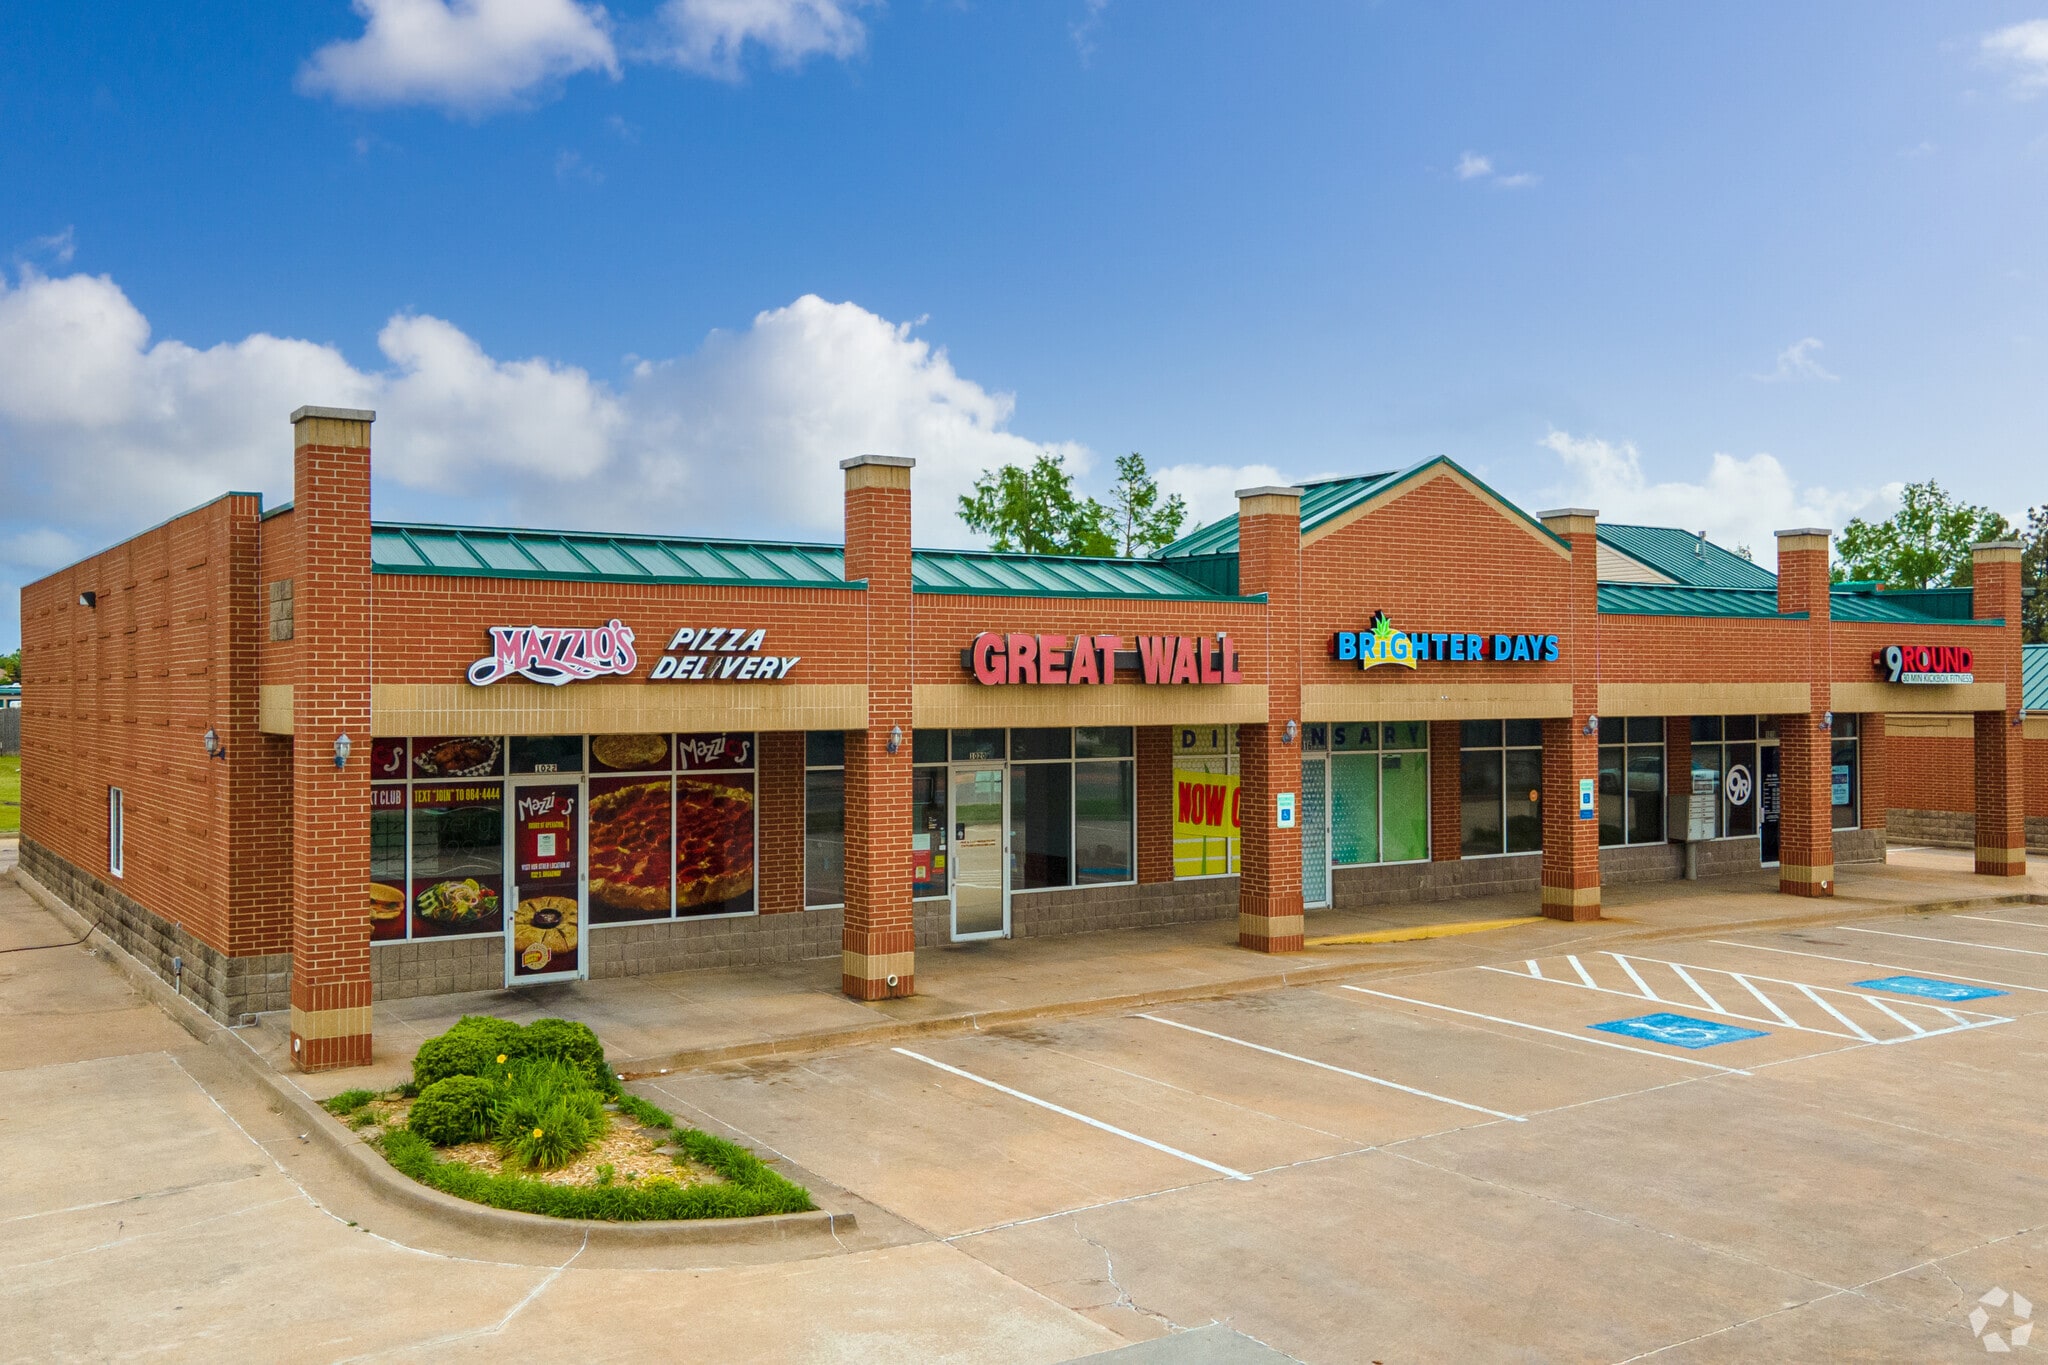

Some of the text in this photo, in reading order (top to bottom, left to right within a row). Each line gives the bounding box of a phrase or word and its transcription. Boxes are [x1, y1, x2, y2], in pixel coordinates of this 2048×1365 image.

[667, 628, 766, 651] PIZZA
[1493, 634, 1559, 661] DAYS
[468, 619, 638, 686] MAZZIO'S
[971, 632, 1242, 685] GREAT WALL
[536, 764, 557, 773] 1022
[380, 790, 401, 805] CLUB
[415, 790, 430, 803] TEXT
[456, 789, 465, 800] TO
[1178, 781, 1226, 826] NOW
